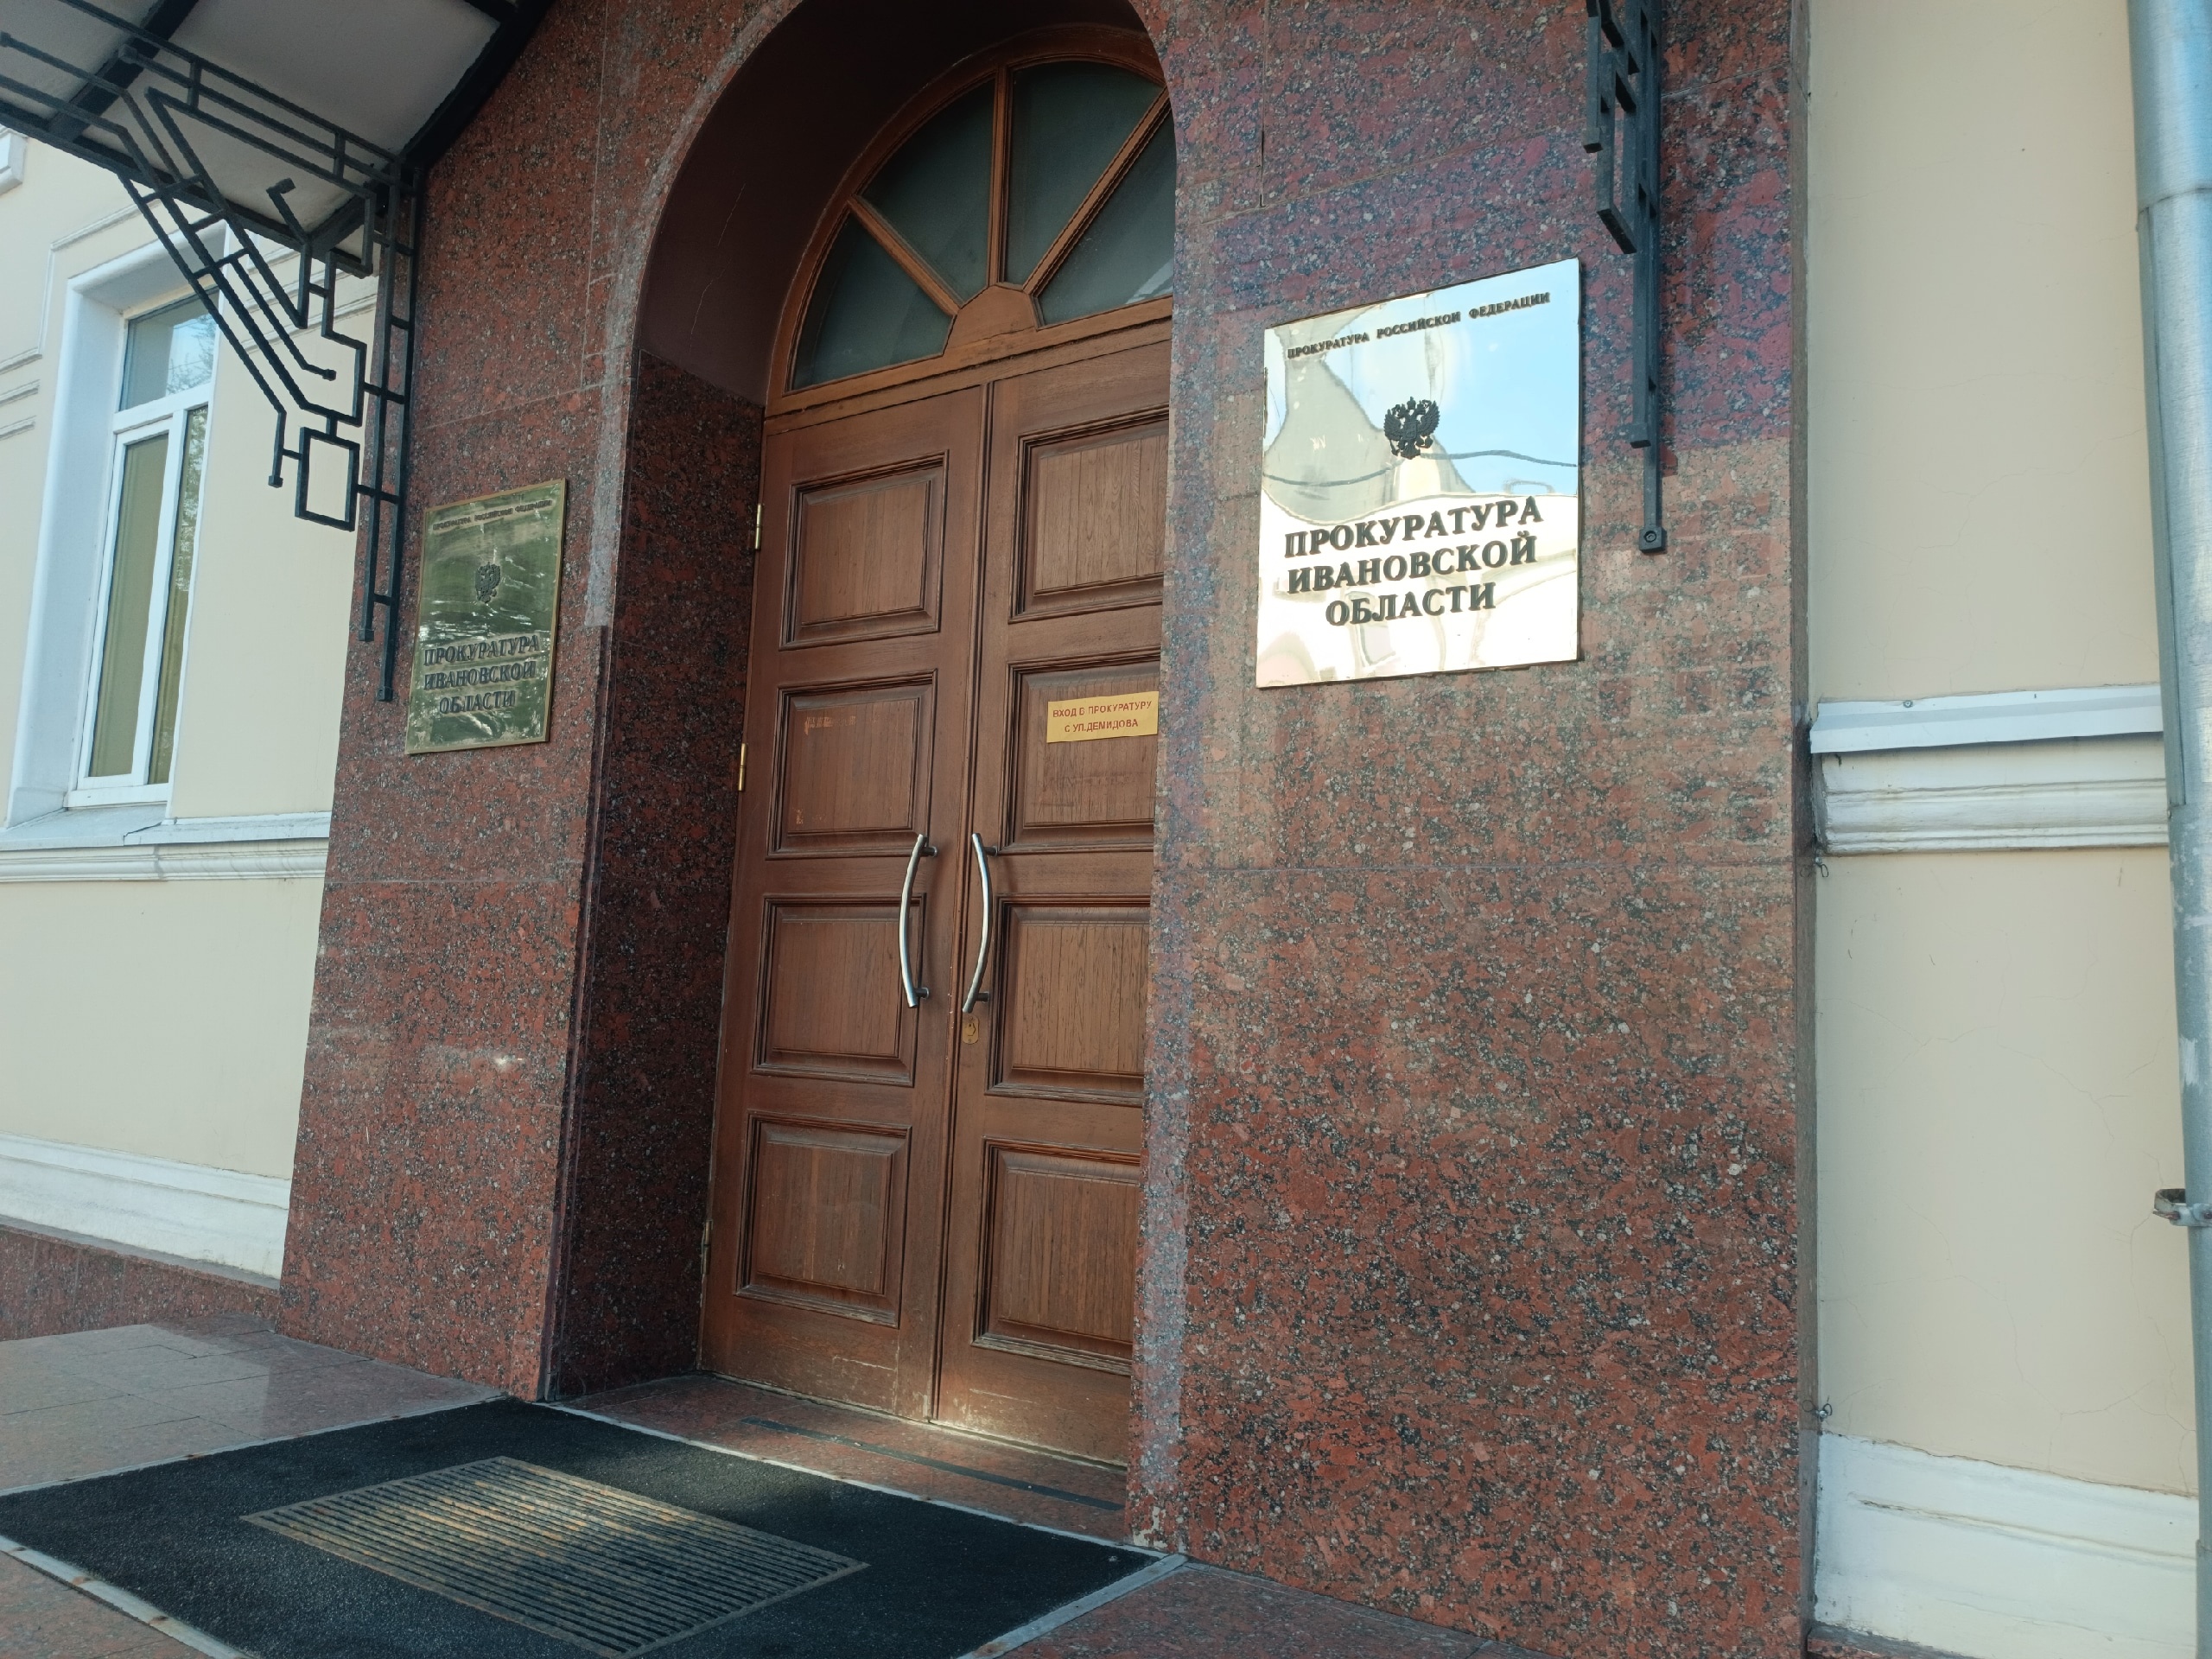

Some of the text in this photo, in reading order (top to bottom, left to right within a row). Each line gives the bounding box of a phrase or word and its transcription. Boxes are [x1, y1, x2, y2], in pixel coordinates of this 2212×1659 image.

[1287, 332, 1370, 359] ПРОКУРАТУРА
[1469, 292, 1551, 319] ФЕДЕРАЦИИ
[1284, 496, 1544, 558] ПРОКУРАТУРА
[1287, 531, 1538, 594] ИВАНОВСКОЙ
[1325, 582, 1497, 626] ОБЛАСТИ
[423, 634, 540, 666] ПРОКУРАТУРА
[439, 690, 517, 715] ОБЛАСТИ
[1052, 701, 1153, 718] ВХОД В ПРОКУРАТУРУ
